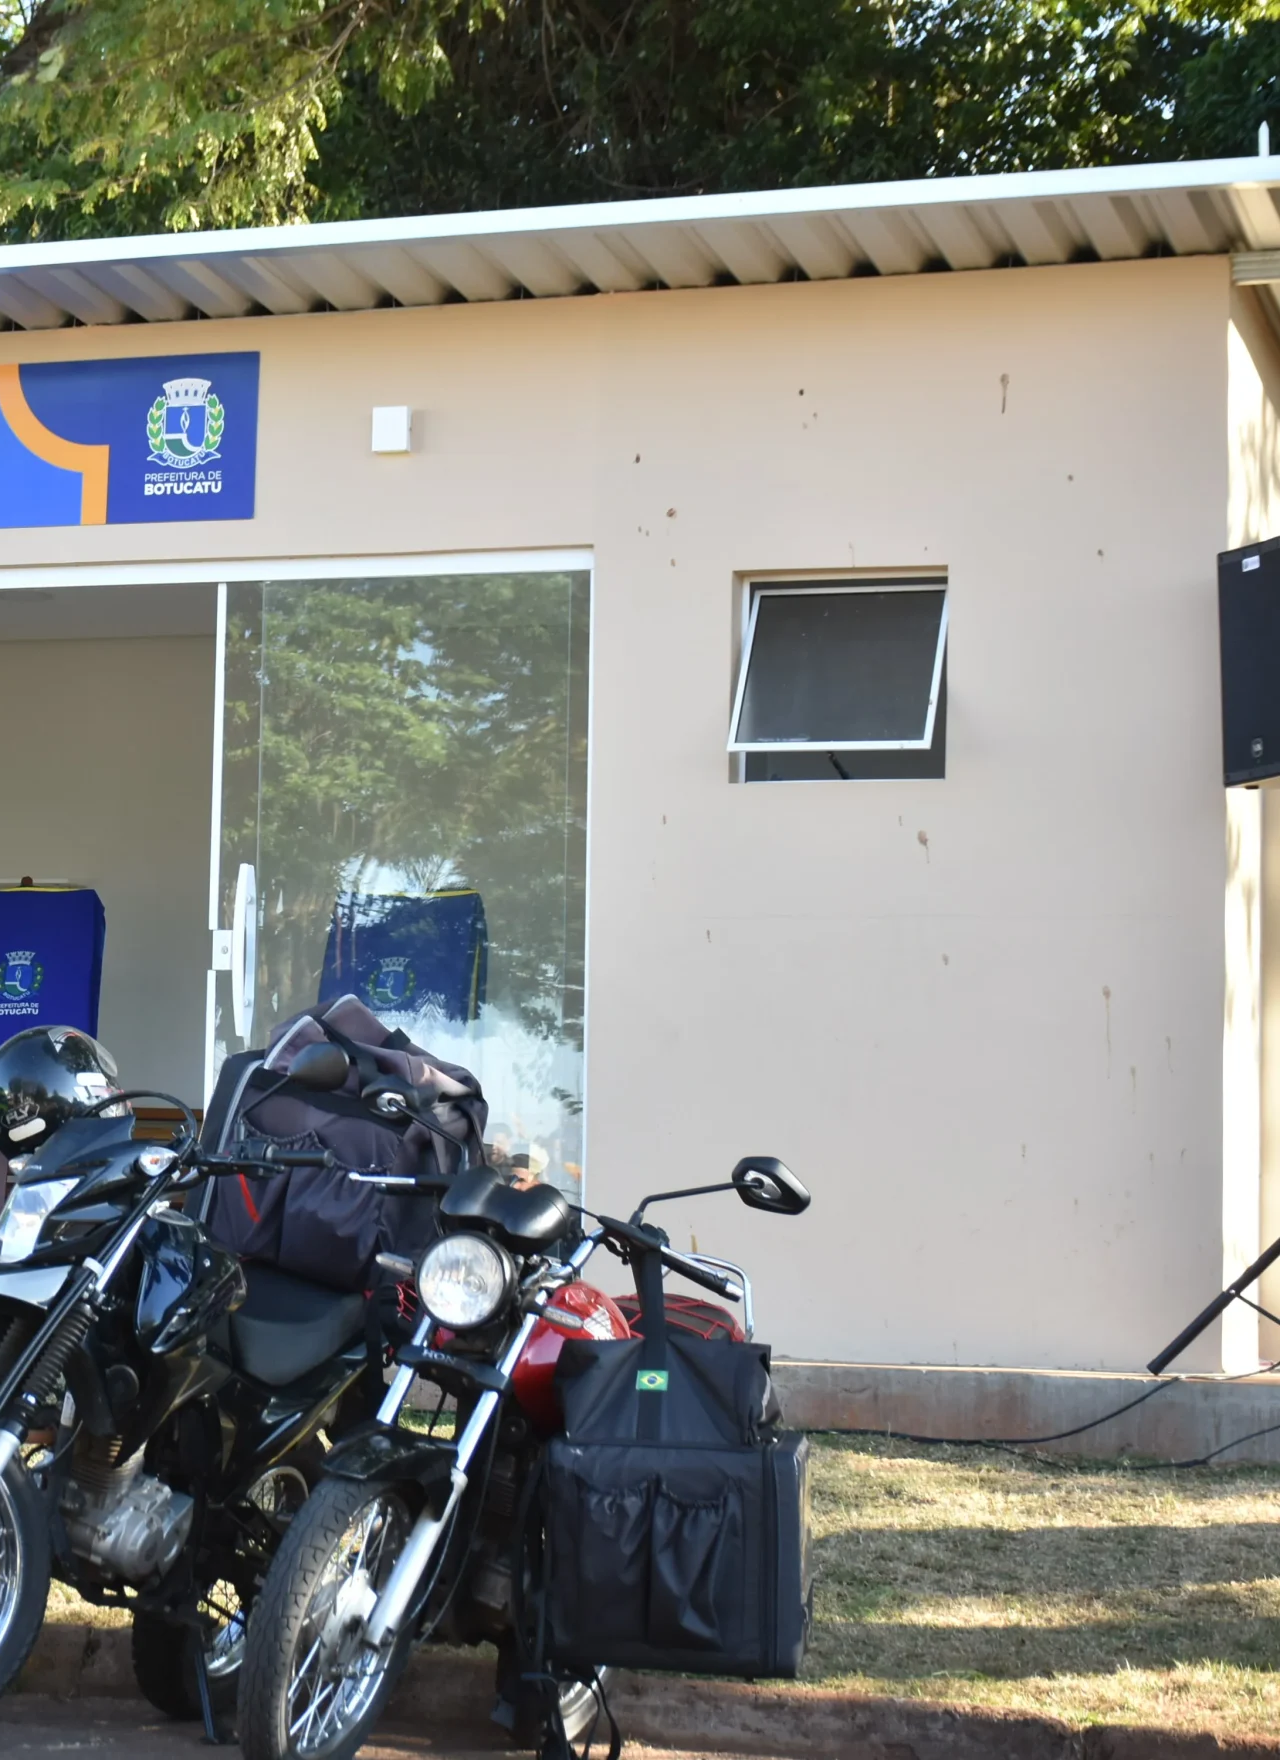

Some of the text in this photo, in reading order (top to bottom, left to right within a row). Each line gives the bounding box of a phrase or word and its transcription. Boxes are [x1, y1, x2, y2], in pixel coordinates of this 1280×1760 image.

[162, 450, 206, 466] BOTUCATU
[144, 470, 222, 482] PREFEITURA DE
[144, 481, 222, 496] BOTUCATU
